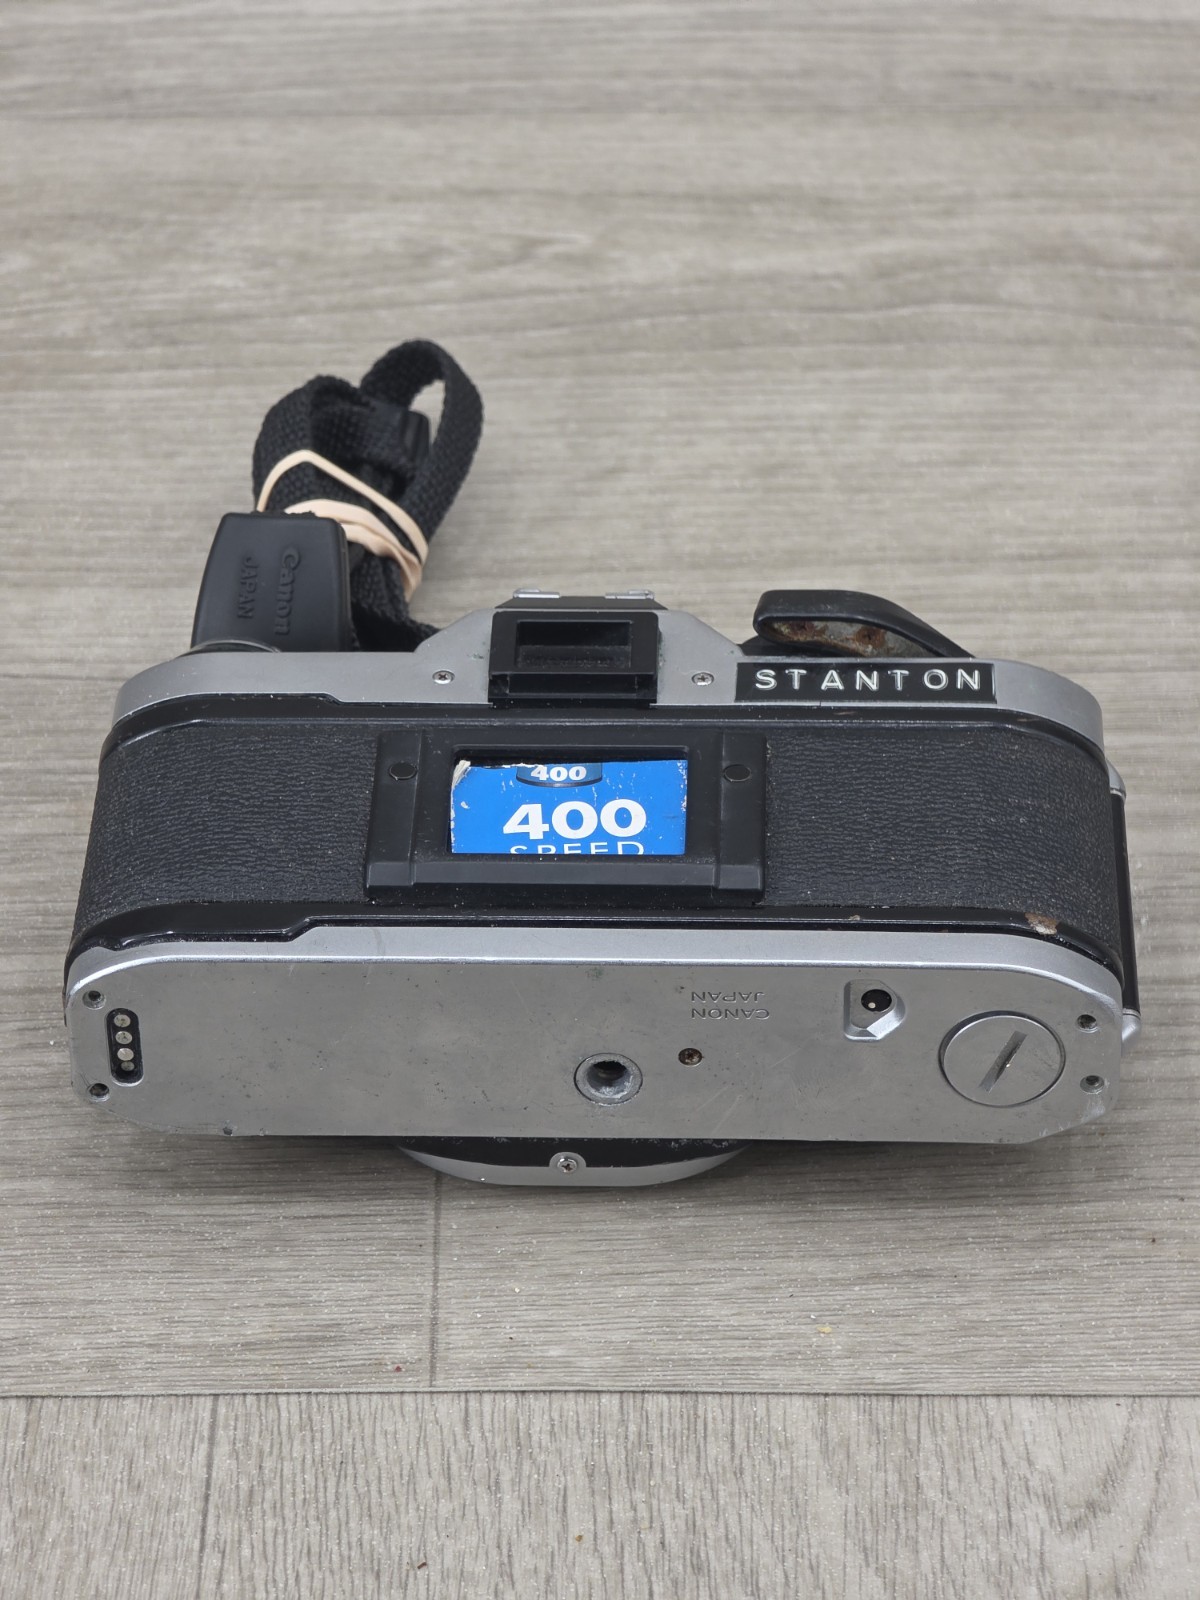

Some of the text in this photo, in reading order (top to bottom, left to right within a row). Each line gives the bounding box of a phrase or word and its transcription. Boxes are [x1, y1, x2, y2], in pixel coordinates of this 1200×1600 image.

[237, 556, 258, 619] JAPAN
[275, 547, 301, 636] Canon
[755, 668, 981, 691] STANTON
[530, 765, 587, 782] 400
[502, 798, 647, 840] 400
[691, 991, 765, 1003] JAPAN
[691, 1008, 770, 1020] CANON
